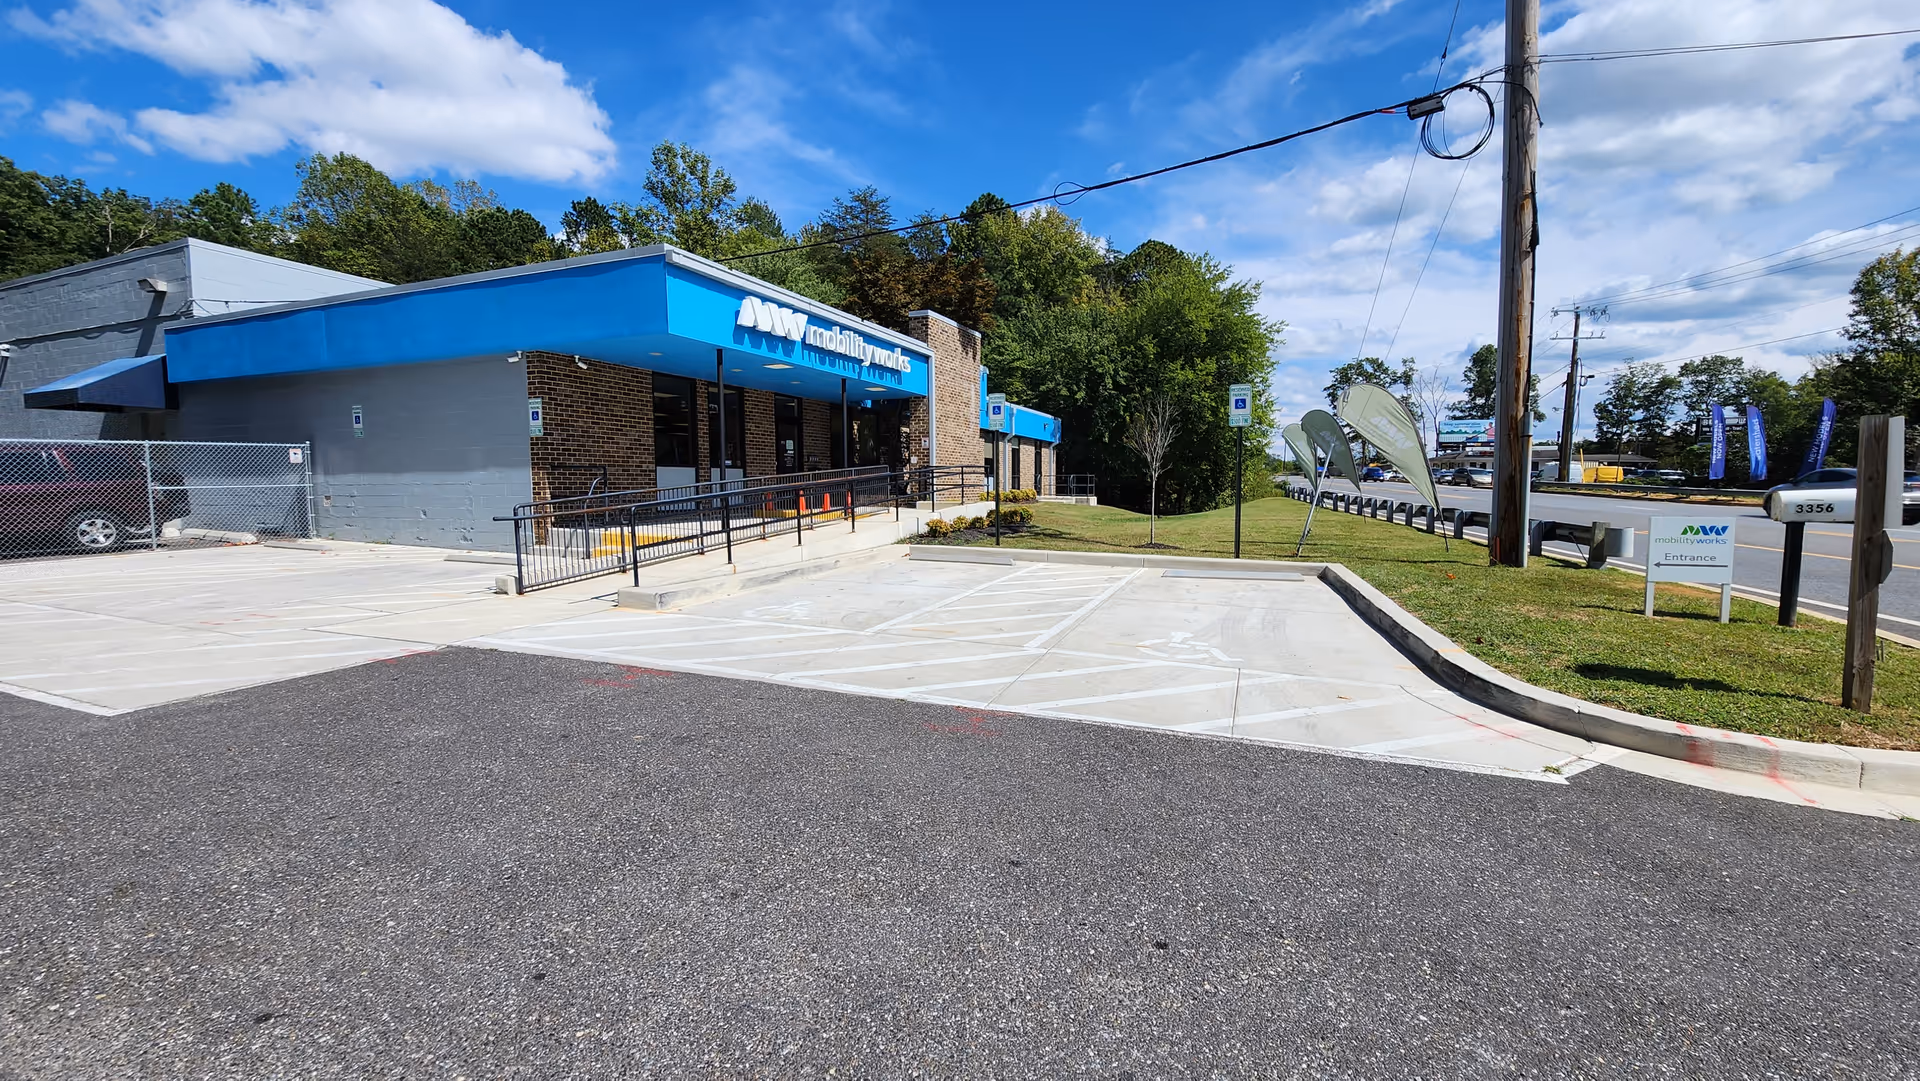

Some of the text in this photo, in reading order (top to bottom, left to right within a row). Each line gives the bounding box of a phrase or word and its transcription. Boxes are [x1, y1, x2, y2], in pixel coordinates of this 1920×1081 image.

[805, 324, 911, 373] mobilityworks
[1795, 503, 1834, 514] 3356
[1655, 536, 1727, 545] mobilityworks
[1664, 552, 1717, 562] Entrance
